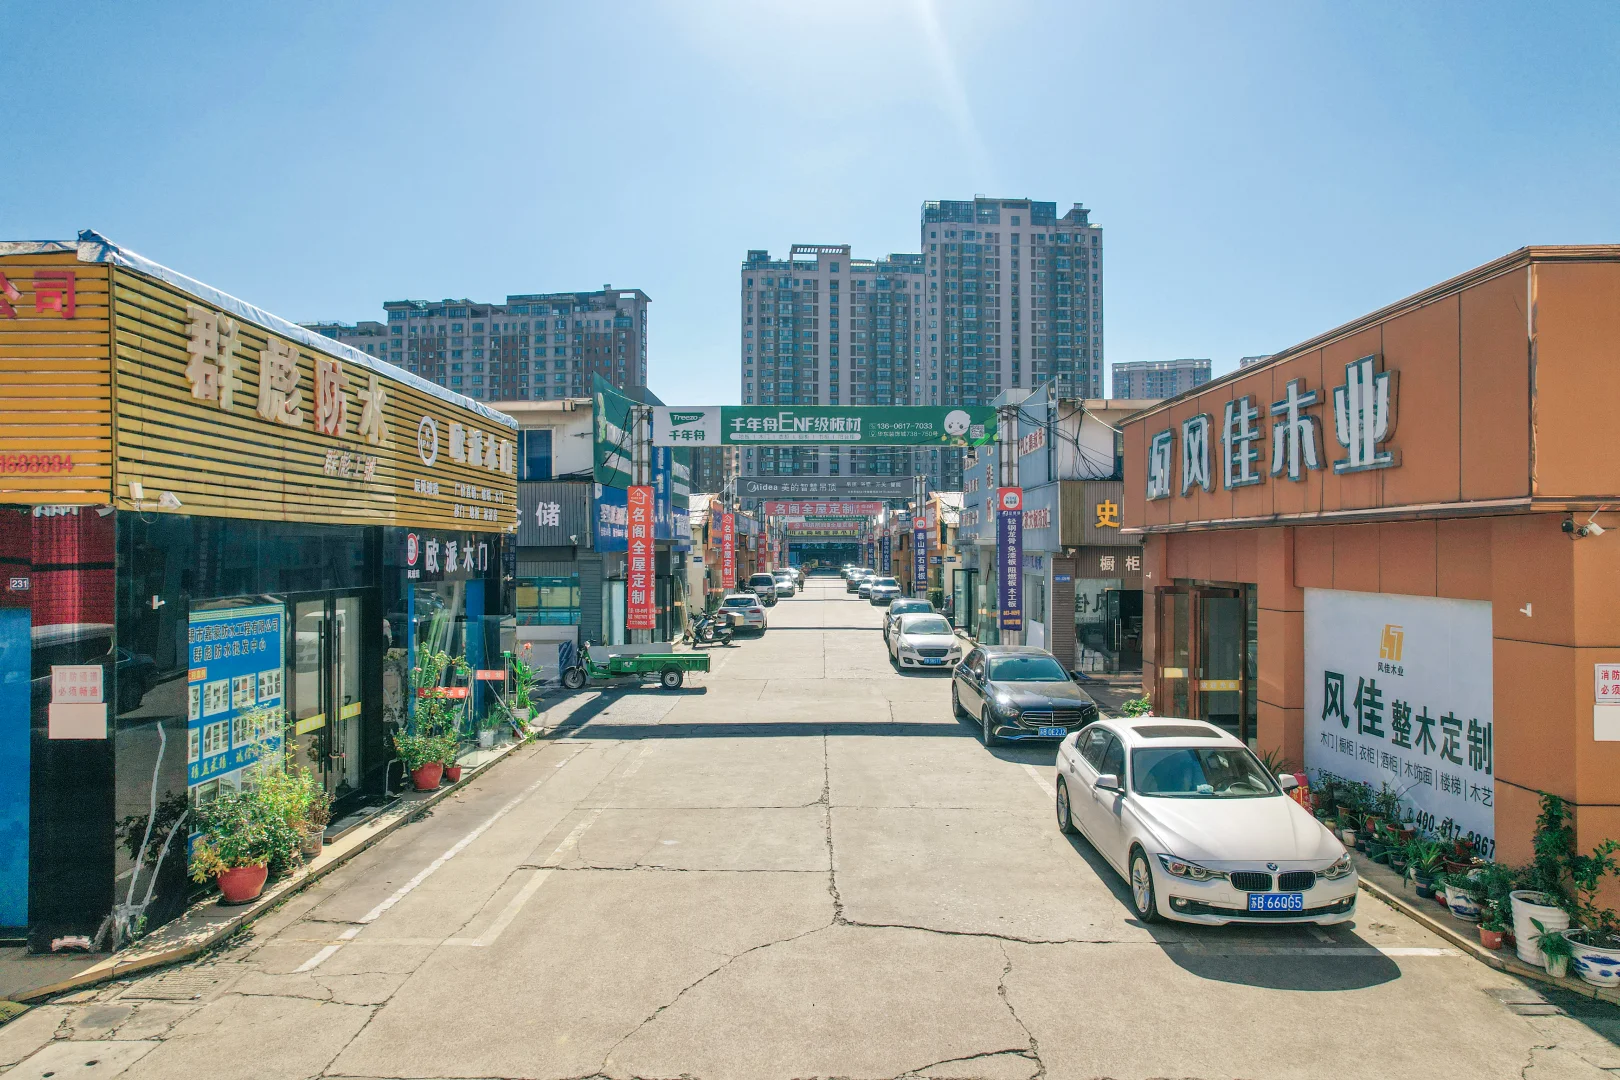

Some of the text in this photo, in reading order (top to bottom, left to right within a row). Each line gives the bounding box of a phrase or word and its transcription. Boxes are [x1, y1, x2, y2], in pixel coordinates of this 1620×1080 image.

[185, 304, 389, 445] 群彪防水
[673, 413, 699, 421] Treezo
[1180, 354, 1401, 498] 风佳木业
[746, 481, 837, 492] Midea 美的智慧吊顶
[426, 538, 488, 573] 欧派木门
[631, 507, 646, 605] 名阁全屋定制
[1100, 555, 1141, 571] 橱柜
[11, 579, 28, 588] 231
[1007, 588, 1017, 607] 木工板
[1377, 661, 1404, 676] 风佳木业
[1321, 670, 1492, 776] 风佳整木定制
